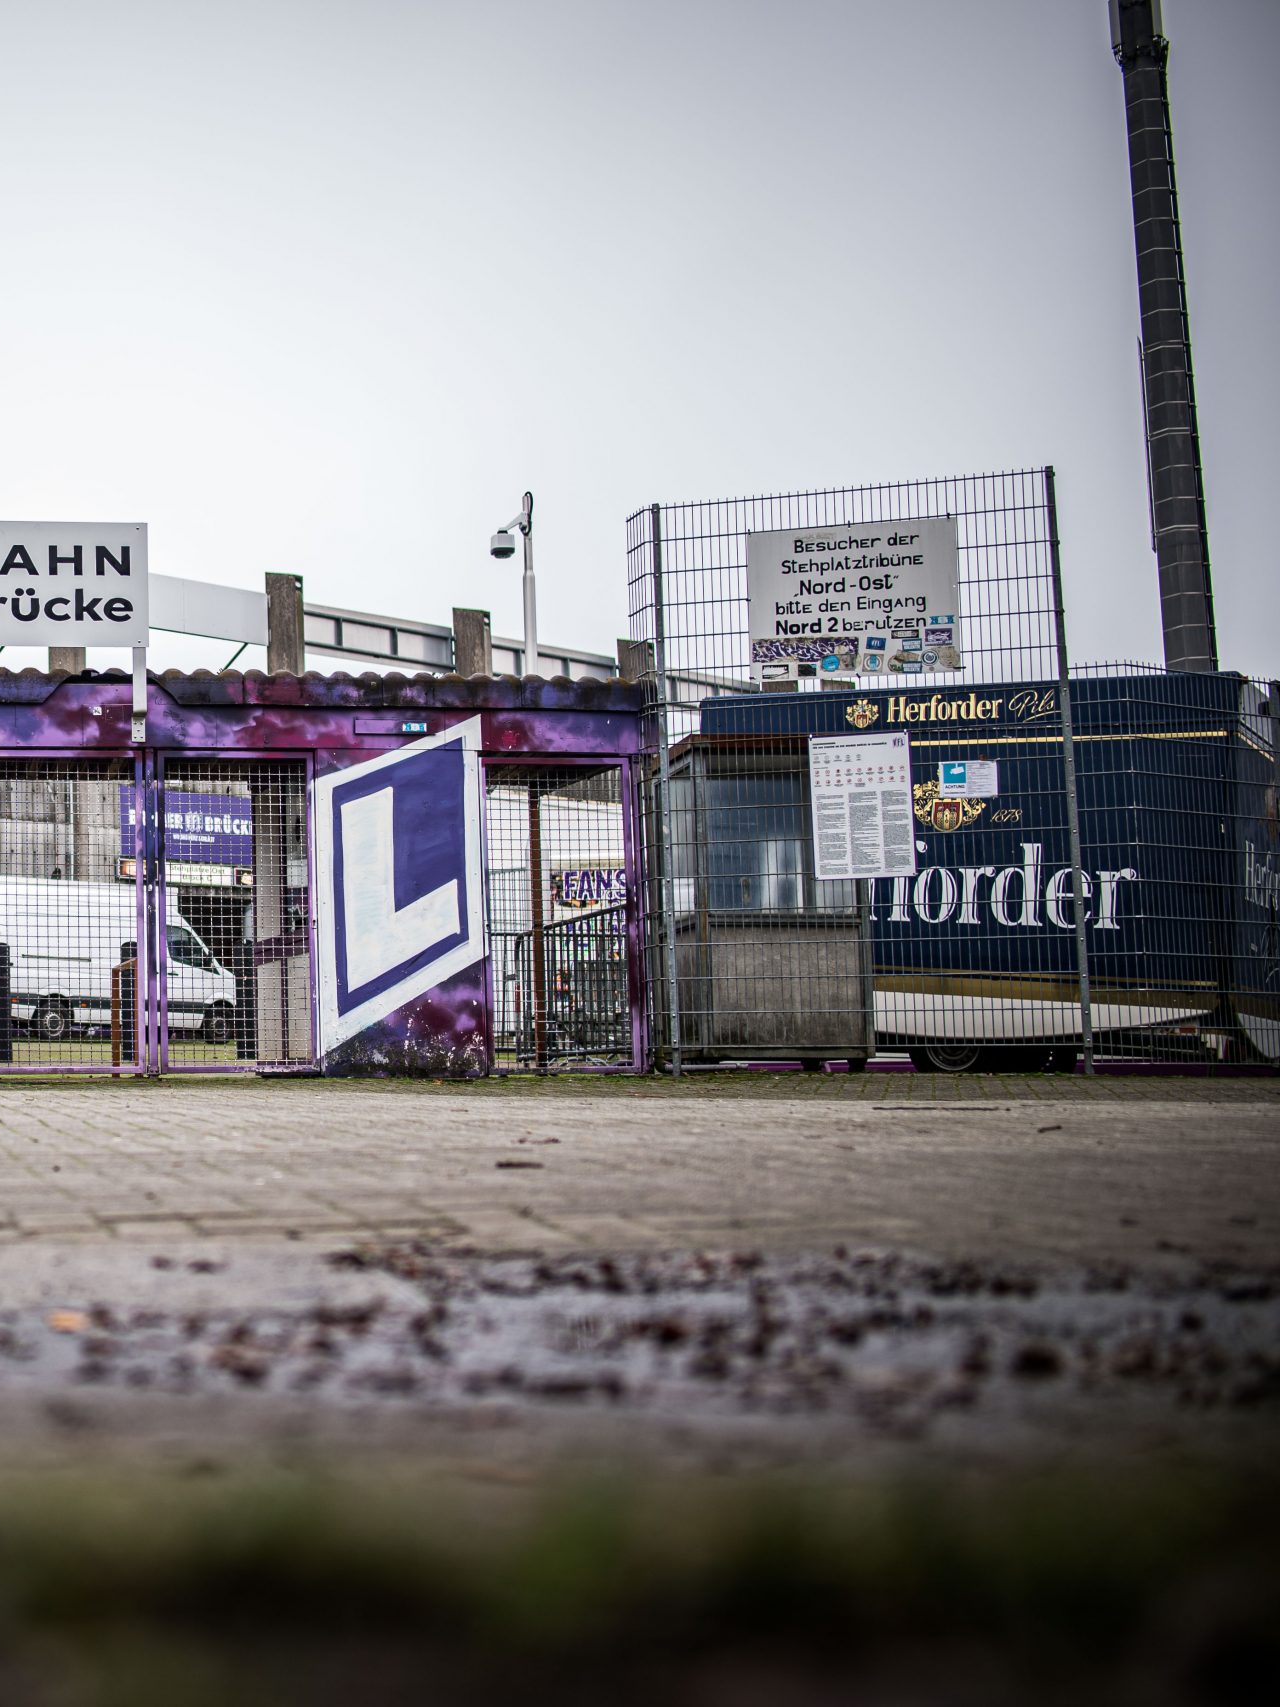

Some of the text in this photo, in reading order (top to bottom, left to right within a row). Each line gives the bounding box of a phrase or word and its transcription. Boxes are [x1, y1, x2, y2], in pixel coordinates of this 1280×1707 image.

[794, 536, 881, 553] Besucher
[887, 532, 920, 546] der
[781, 553, 924, 575] Stehplatztribüne
[775, 596, 926, 616] bitte den Eingang
[775, 618, 822, 636] Nord
[827, 617, 839, 633] 2
[887, 689, 1056, 723] Herforder Pils
[990, 809, 1023, 823] 1878
[1245, 840, 1280, 911] Herfo
